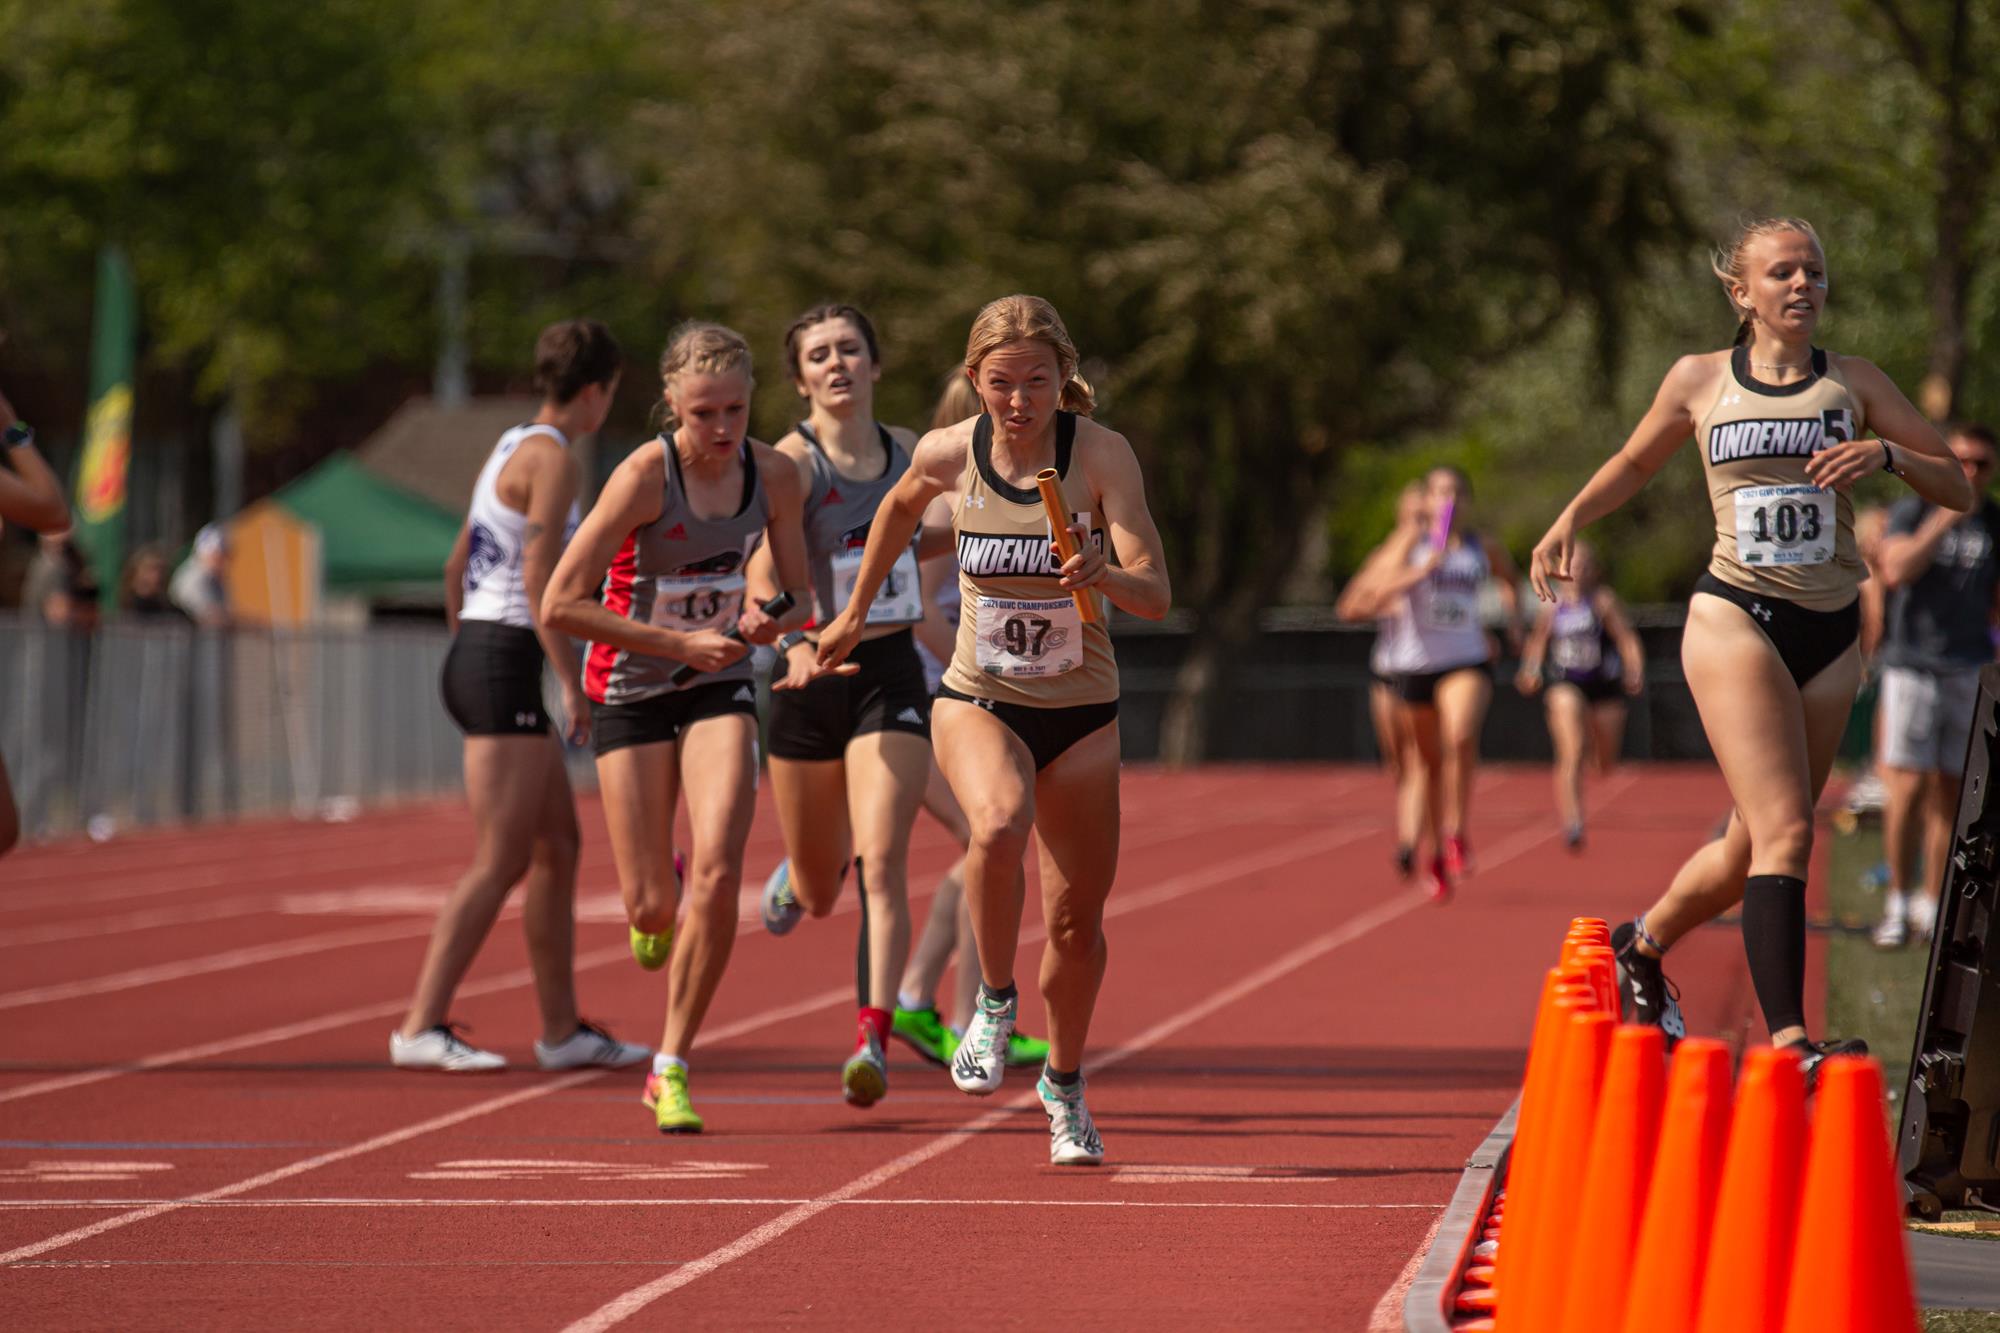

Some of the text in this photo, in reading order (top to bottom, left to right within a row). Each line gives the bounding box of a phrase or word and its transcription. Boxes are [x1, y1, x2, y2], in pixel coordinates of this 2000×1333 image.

[1711, 421, 1821, 463] LINDENW
[1823, 409, 1848, 449] 5
[1754, 503, 1822, 543] 103
[959, 535, 1052, 574] LINDENW
[1017, 599, 1074, 611] CHAMPIONSHIPS
[1005, 618, 1052, 656] 97
